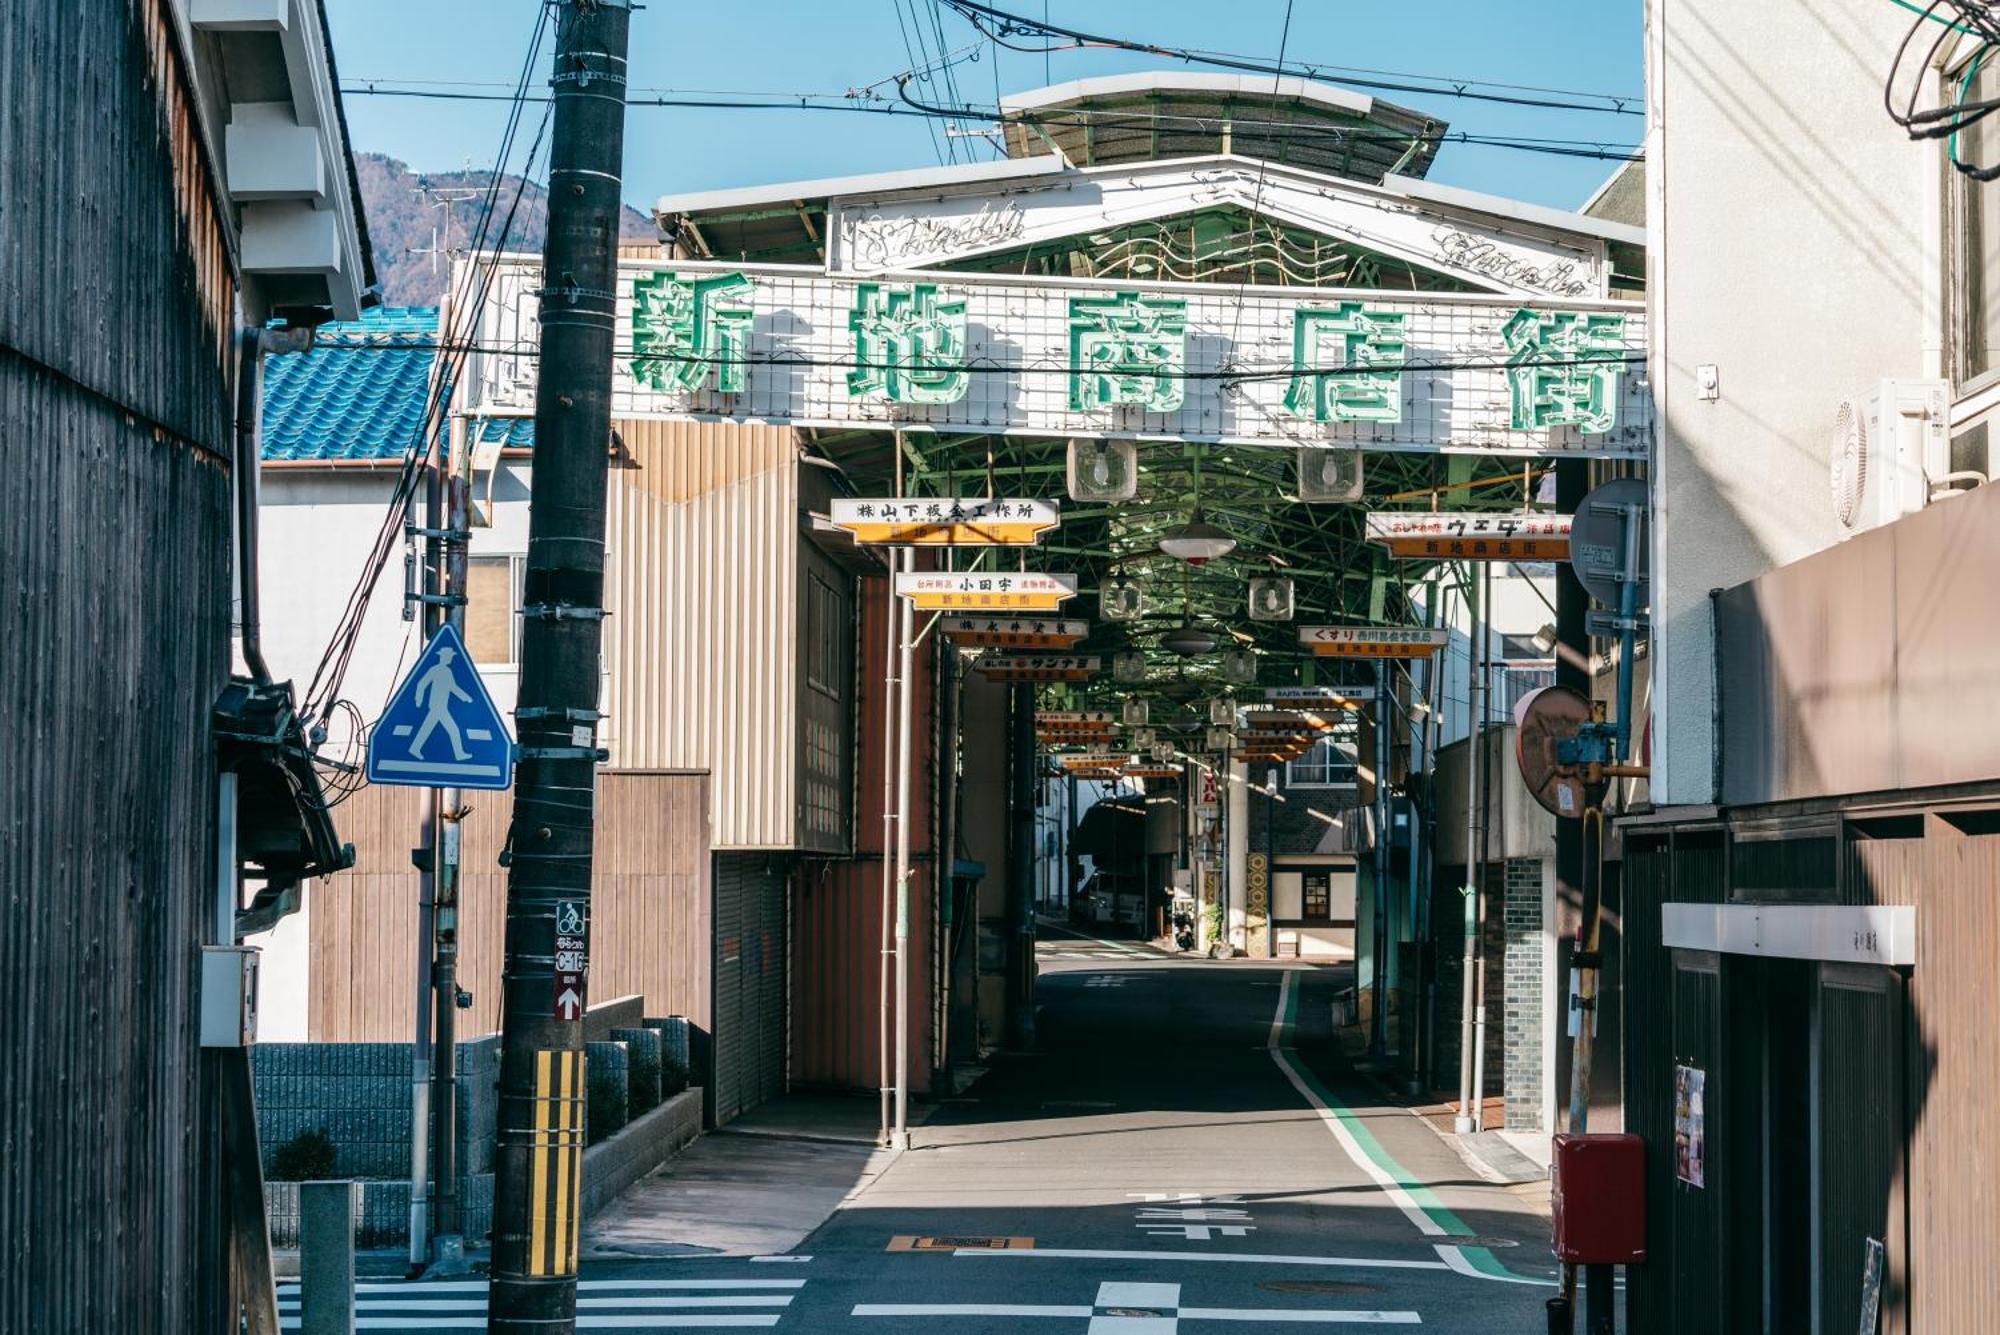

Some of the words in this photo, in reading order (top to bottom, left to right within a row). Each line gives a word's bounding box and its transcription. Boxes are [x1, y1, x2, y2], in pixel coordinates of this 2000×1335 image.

[631, 271, 1627, 434] 新地商店街
[1426, 541, 1537, 555] 新地商店街
[942, 594, 1031, 606] 新地商店街
[1314, 629, 1354, 642] くすり
[558, 952, 584, 971] C-16
